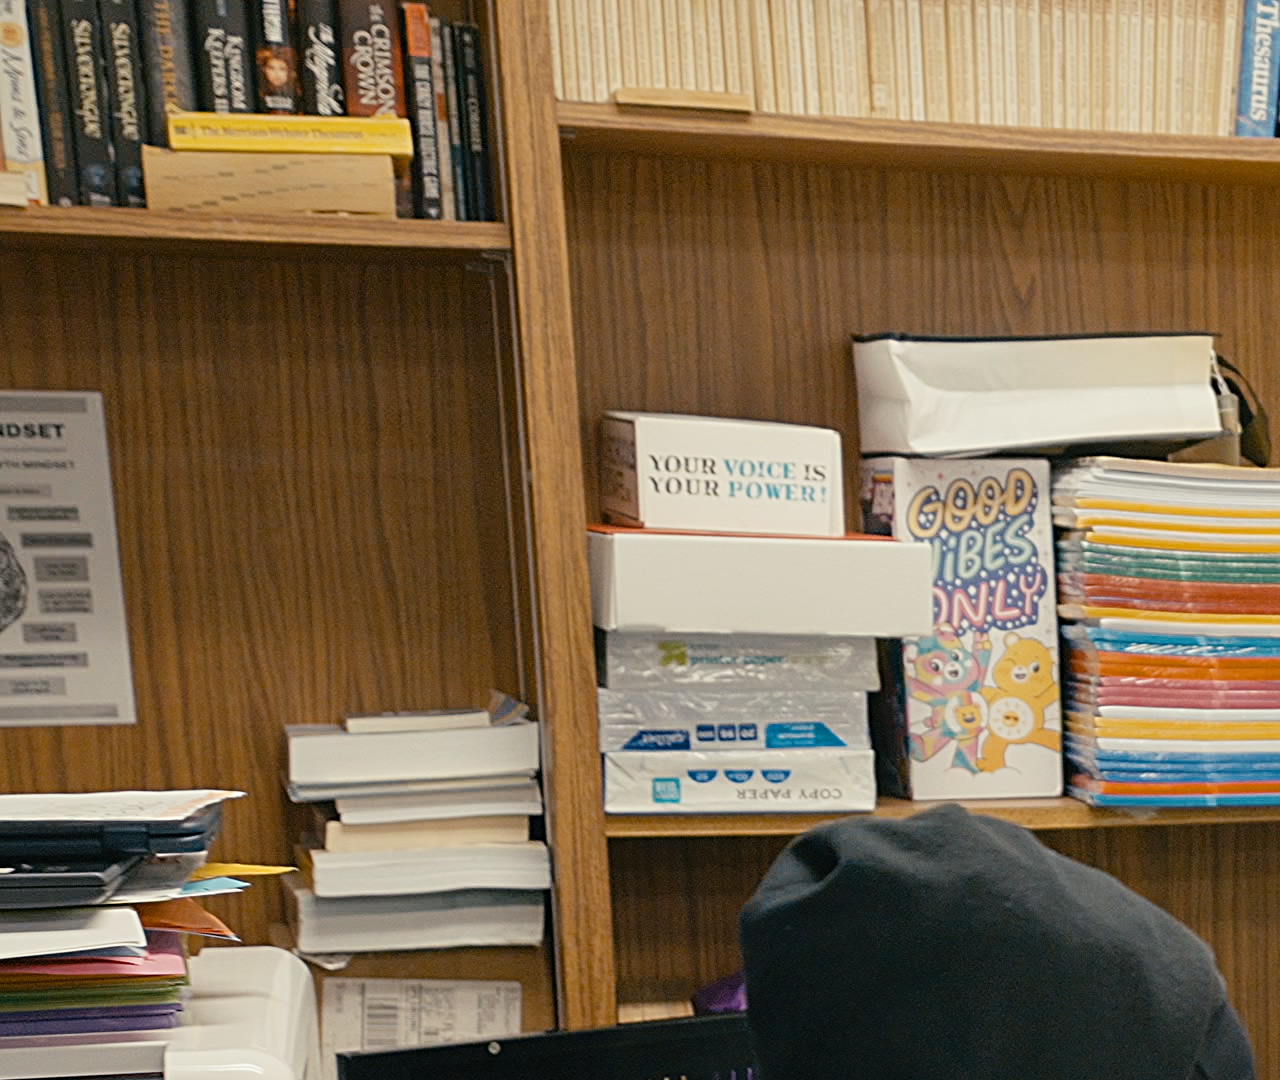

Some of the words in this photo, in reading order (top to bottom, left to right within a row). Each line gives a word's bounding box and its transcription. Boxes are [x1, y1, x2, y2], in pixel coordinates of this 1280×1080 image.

[349, 30, 379, 105] CROWN
[369, 23, 397, 117] CRIMSON
[1250, 0, 1280, 121] Thesaurus
[648, 453, 718, 476] YOUR
[723, 458, 797, 481] VOICE
[803, 463, 828, 482] IS
[648, 477, 719, 497] YOUR
[728, 481, 829, 503] POWER!
[907, 467, 1037, 538] GOOD
[735, 788, 792, 800] PAPER
[799, 788, 843, 800] COPY
